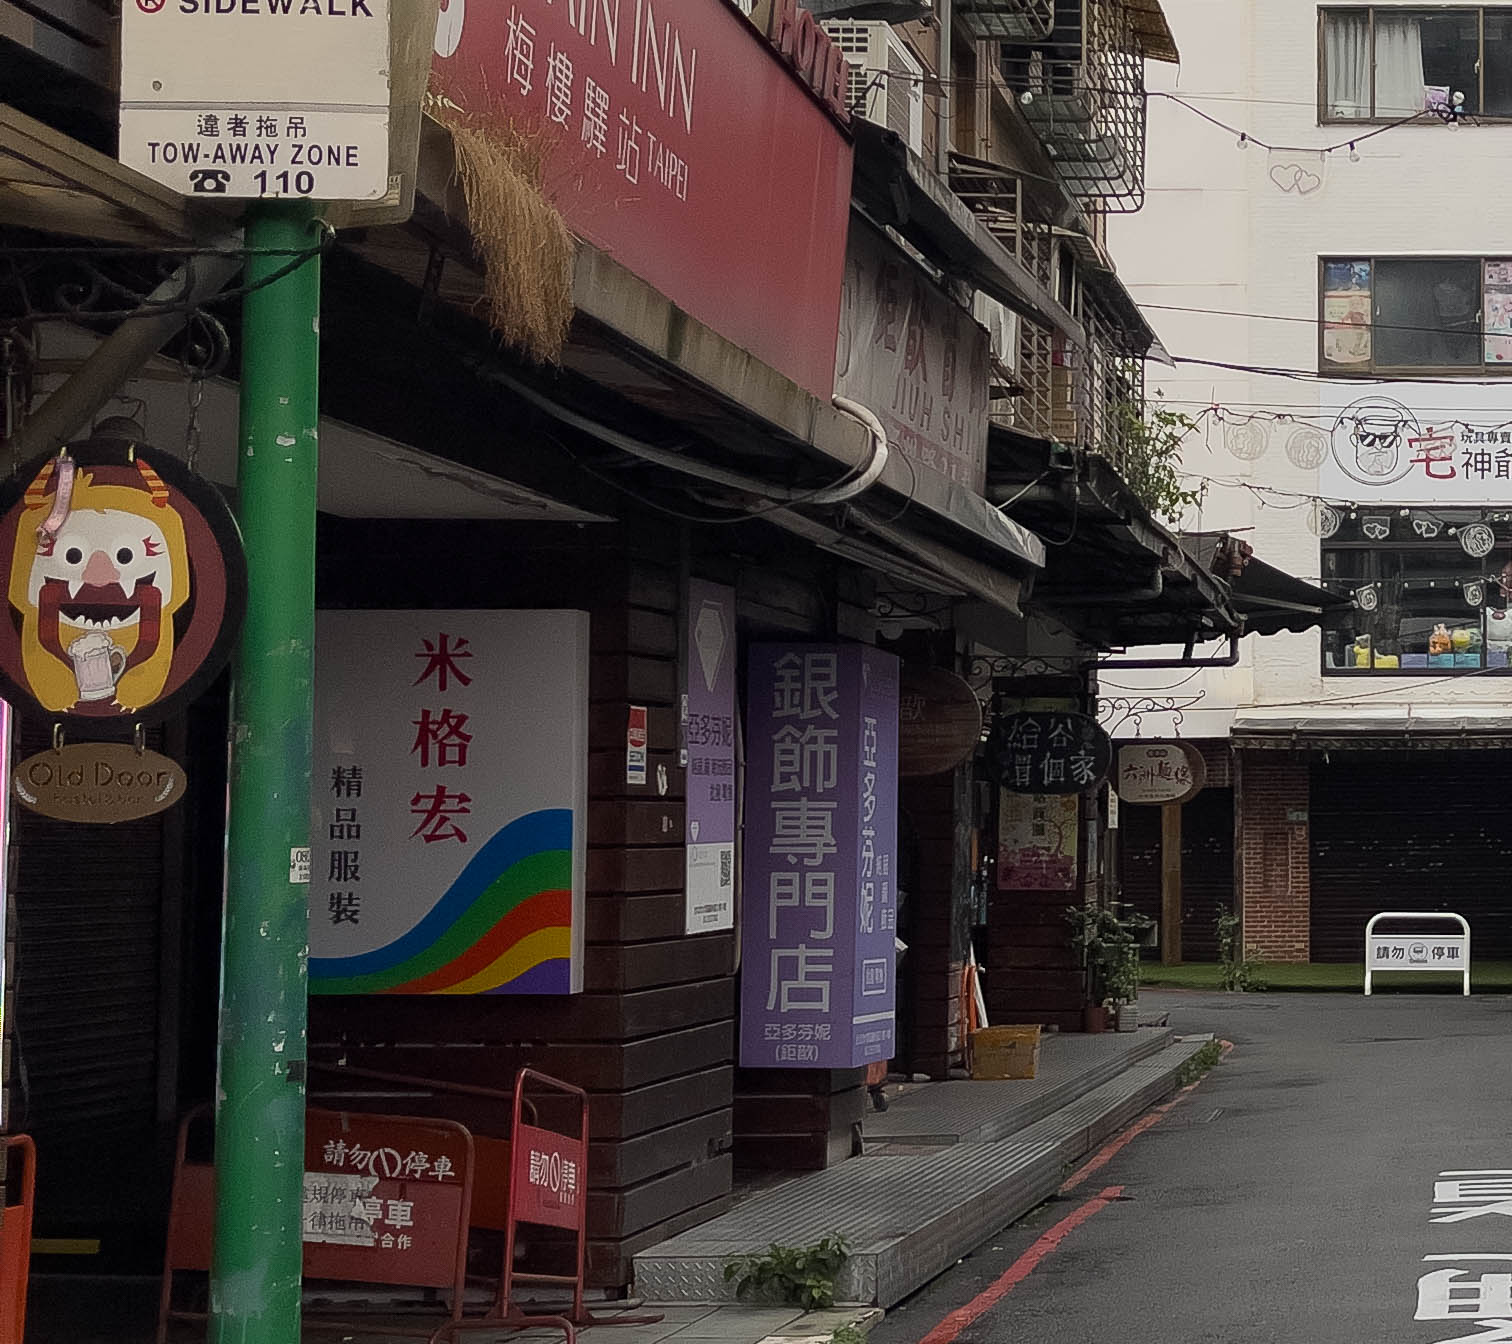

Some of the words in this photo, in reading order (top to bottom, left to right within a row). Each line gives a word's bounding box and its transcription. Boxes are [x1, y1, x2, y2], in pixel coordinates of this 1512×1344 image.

[504, 5, 640, 186] 梅樓驛站
[646, 129, 689, 202] TAIPEI
[196, 113, 308, 139] 違者拖吊
[148, 141, 280, 167] TOW-AWAY
[290, 142, 359, 167] ZONE
[253, 170, 314, 195] 110
[410, 633, 474, 845] 米格宏
[29, 761, 84, 787] Old
[94, 761, 168, 787] Door
[327, 765, 363, 925] 精品服裝
[766, 652, 839, 1015] 銀飾專門店
[1375, 945, 1405, 961] 請勿
[1431, 945, 1460, 961] 停車
[763, 1023, 832, 1042] 亞多芬妮
[322, 1138, 372, 1171] 請勿
[403, 1150, 456, 1182] 停車
